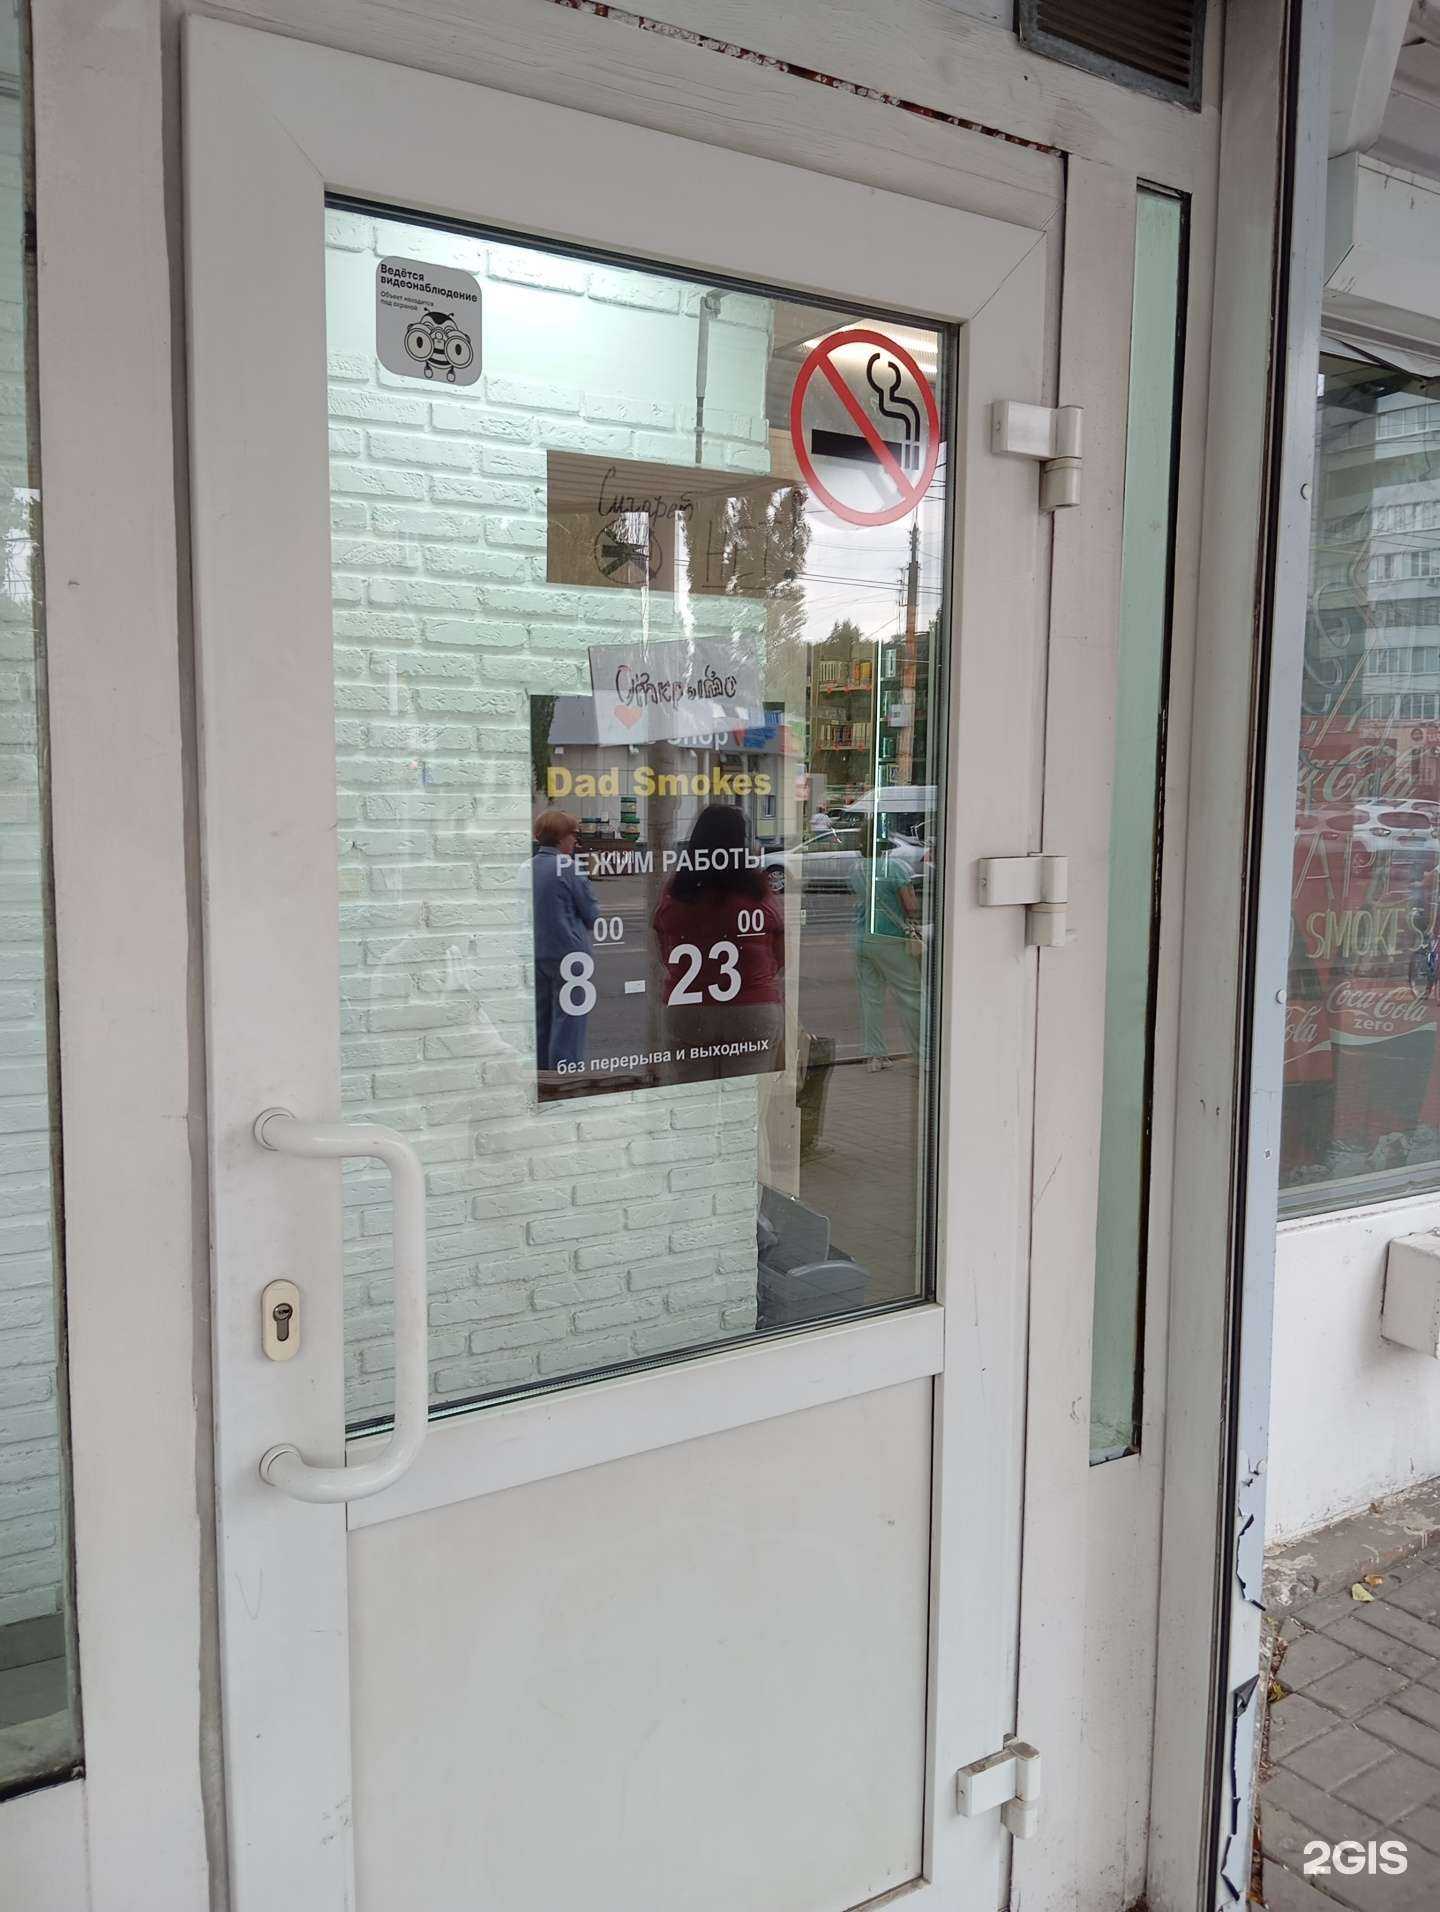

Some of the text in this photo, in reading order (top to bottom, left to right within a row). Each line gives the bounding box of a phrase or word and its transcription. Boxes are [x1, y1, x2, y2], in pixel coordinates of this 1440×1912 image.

[380, 263, 425, 282] Ведётся
[380, 276, 478, 303] видеонаблюдение
[546, 766, 772, 798] Dad Smokes
[556, 850, 653, 877] РЕЖИМ
[662, 847, 766, 872] РАБОТЫ
[558, 951, 597, 1016] 8
[593, 916, 625, 942] 00
[667, 940, 742, 1008] 23
[737, 908, 765, 934] 00
[1326, 981, 1428, 1022] Coca-Cola
[1285, 1005, 1321, 1043] ola
[1352, 1018, 1394, 1032] zero
[556, 1039, 769, 1075] без перерыва и выходных
